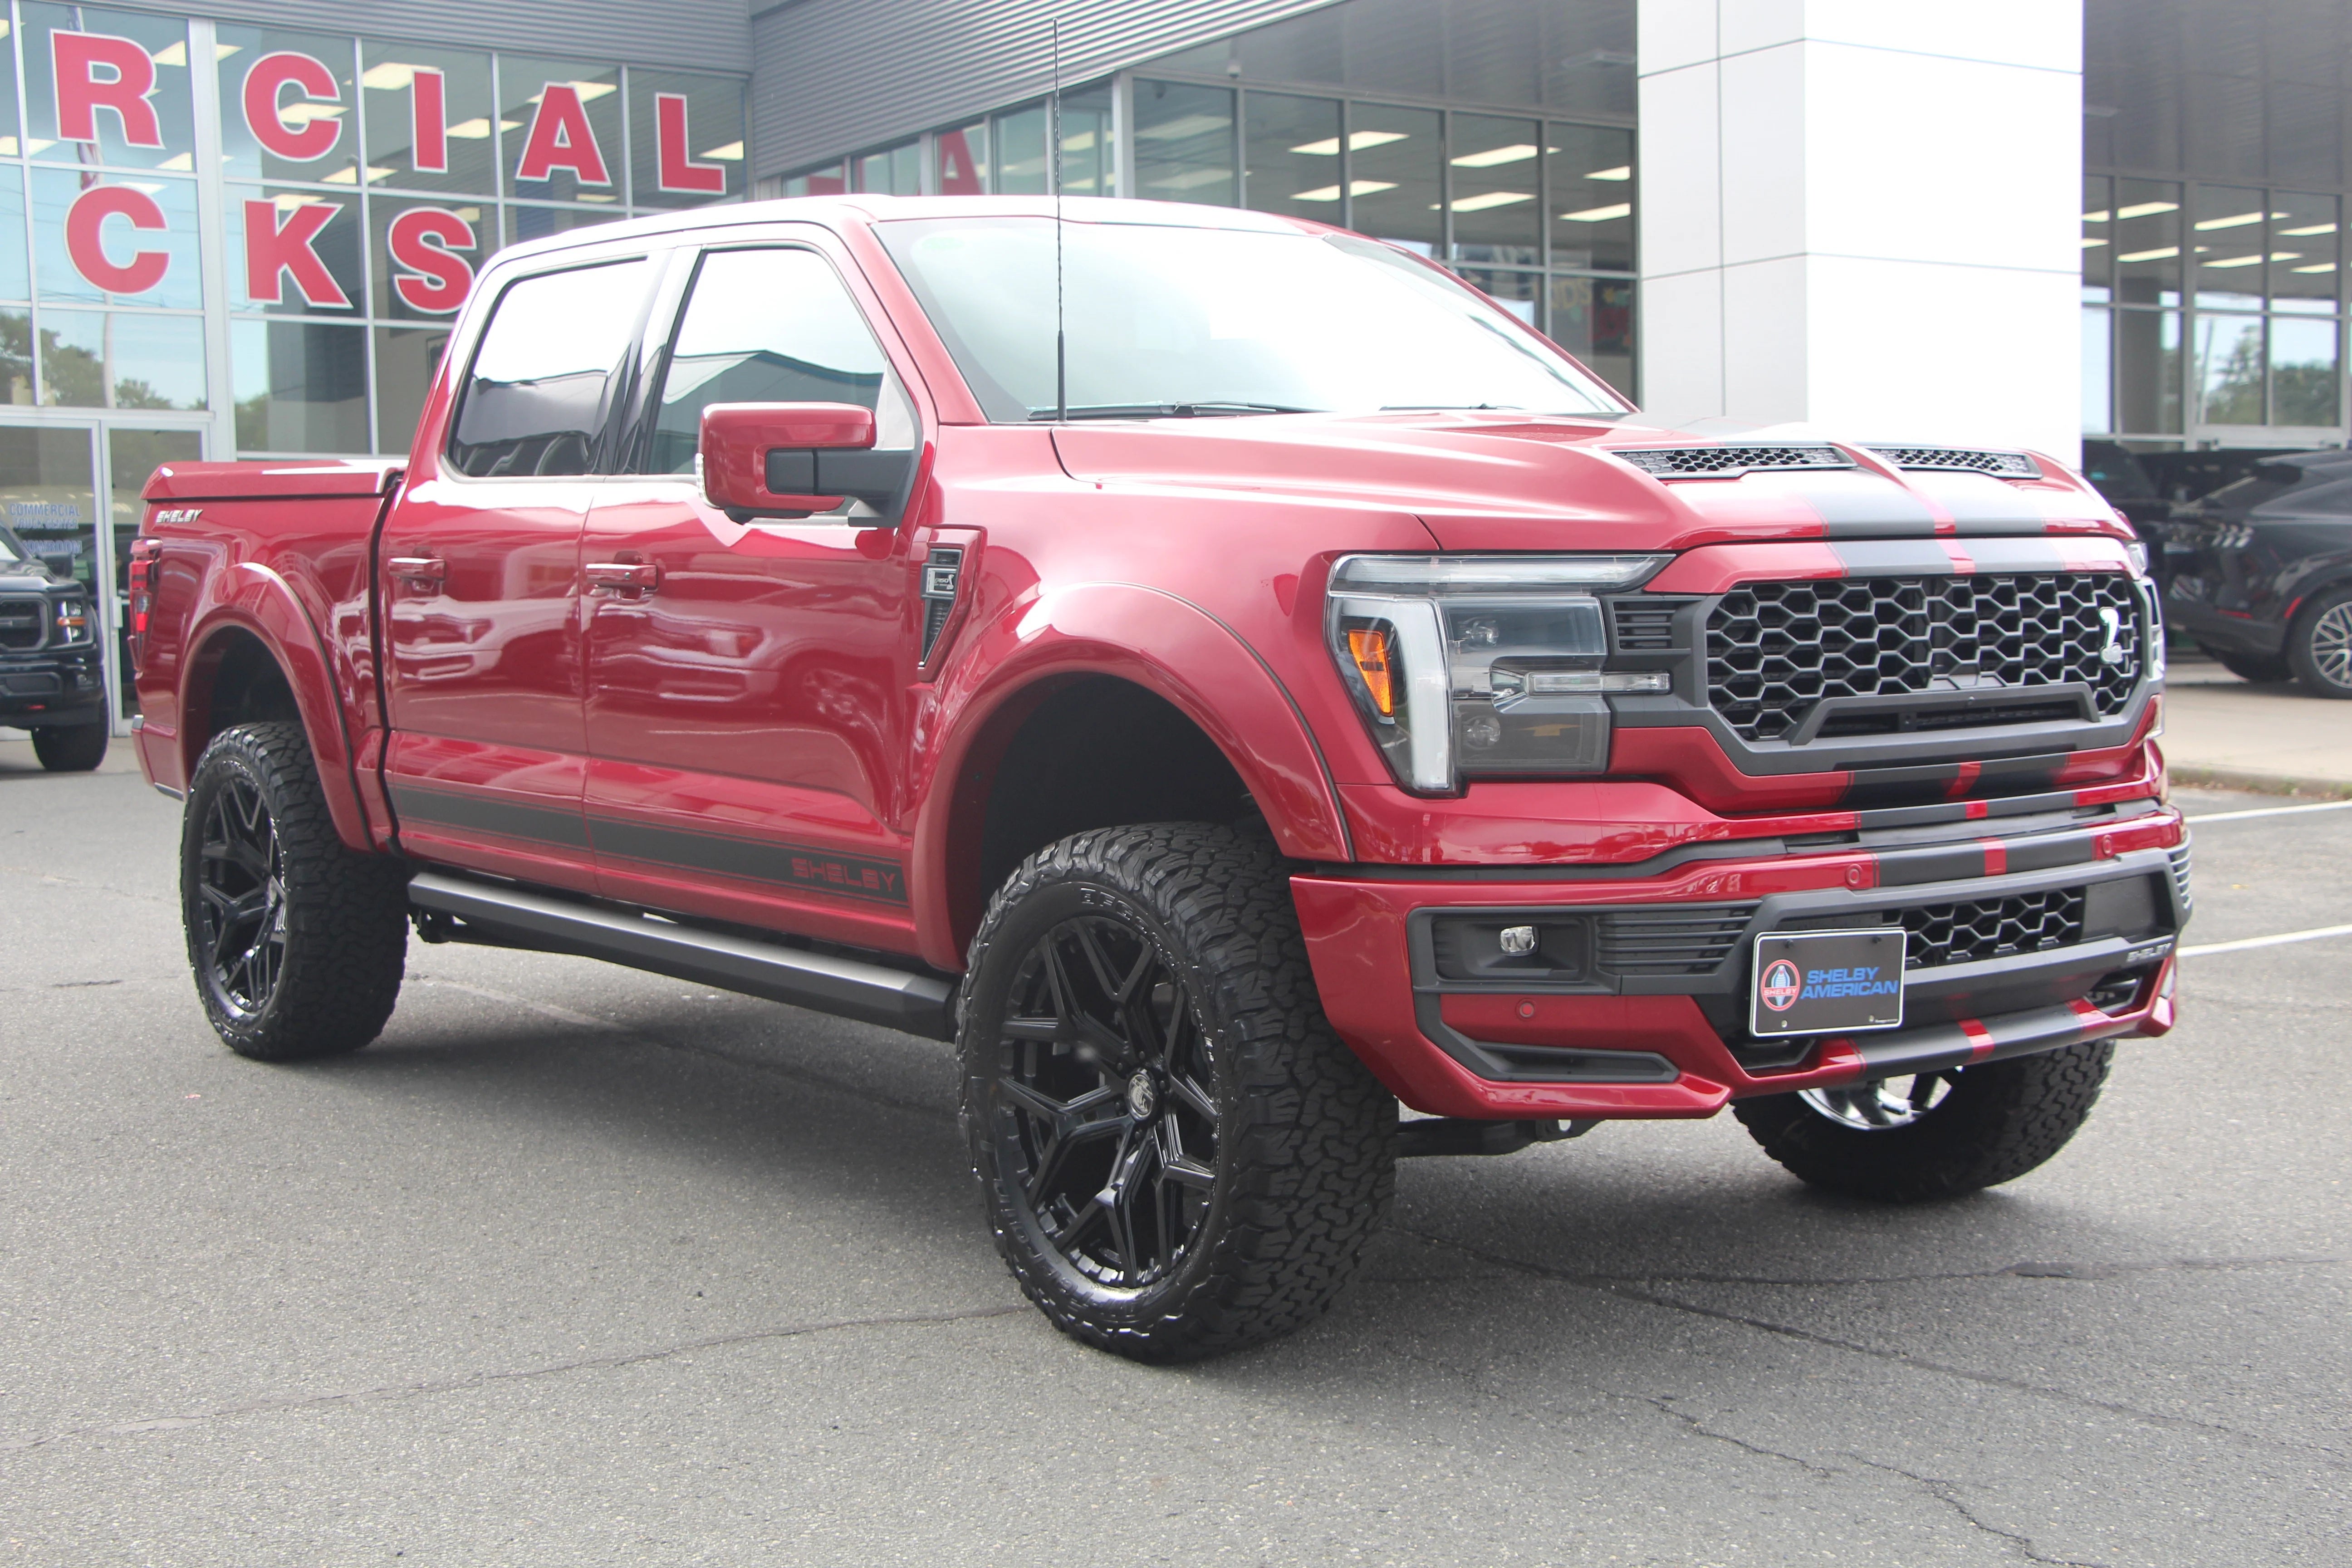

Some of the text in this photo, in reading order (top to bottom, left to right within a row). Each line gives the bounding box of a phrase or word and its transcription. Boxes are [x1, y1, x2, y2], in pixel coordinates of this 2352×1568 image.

[10, 503, 82, 518] COMMERCIAL
[156, 509, 203, 523] SHELBY
[15, 518, 44, 529] TRUCK
[791, 858, 896, 891] SHELBY
[1807, 967, 1879, 983] SHELBY
[1801, 980, 1899, 999] AMERICAN
